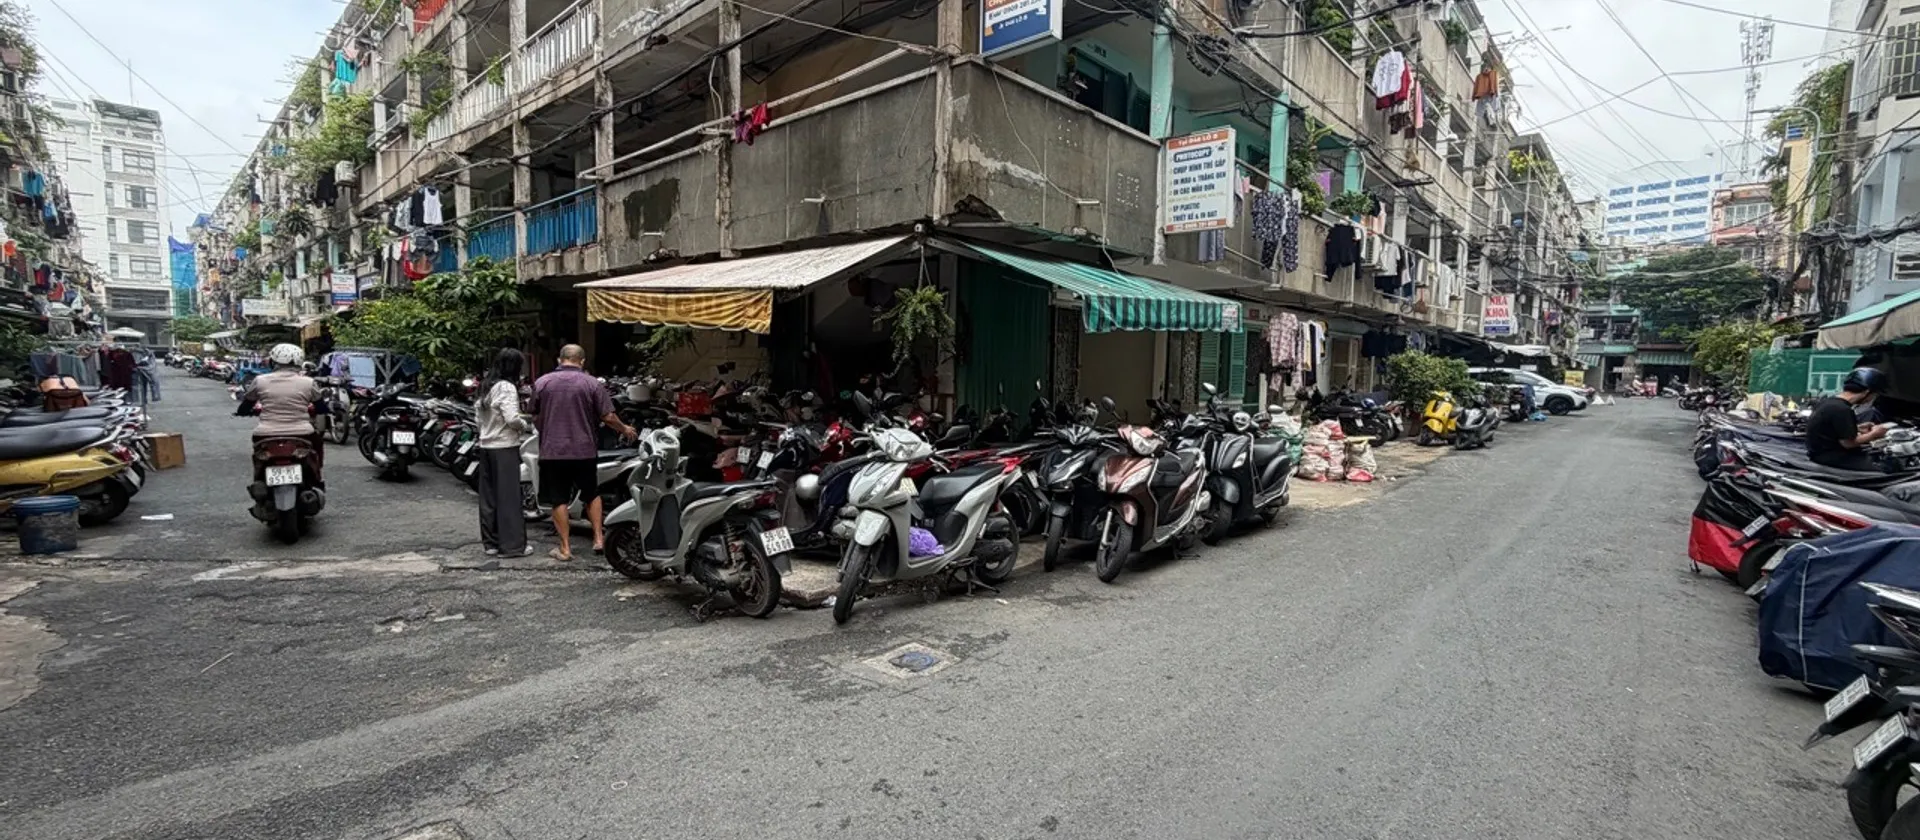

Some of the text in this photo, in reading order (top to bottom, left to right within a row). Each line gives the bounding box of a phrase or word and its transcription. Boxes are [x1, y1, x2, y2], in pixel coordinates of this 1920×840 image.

[1175, 148, 1210, 161] PHOTOCOPY
[1180, 202, 1200, 211] PLASTIC
[1490, 296, 1507, 305] NHA
[1485, 308, 1509, 318] KHOA
